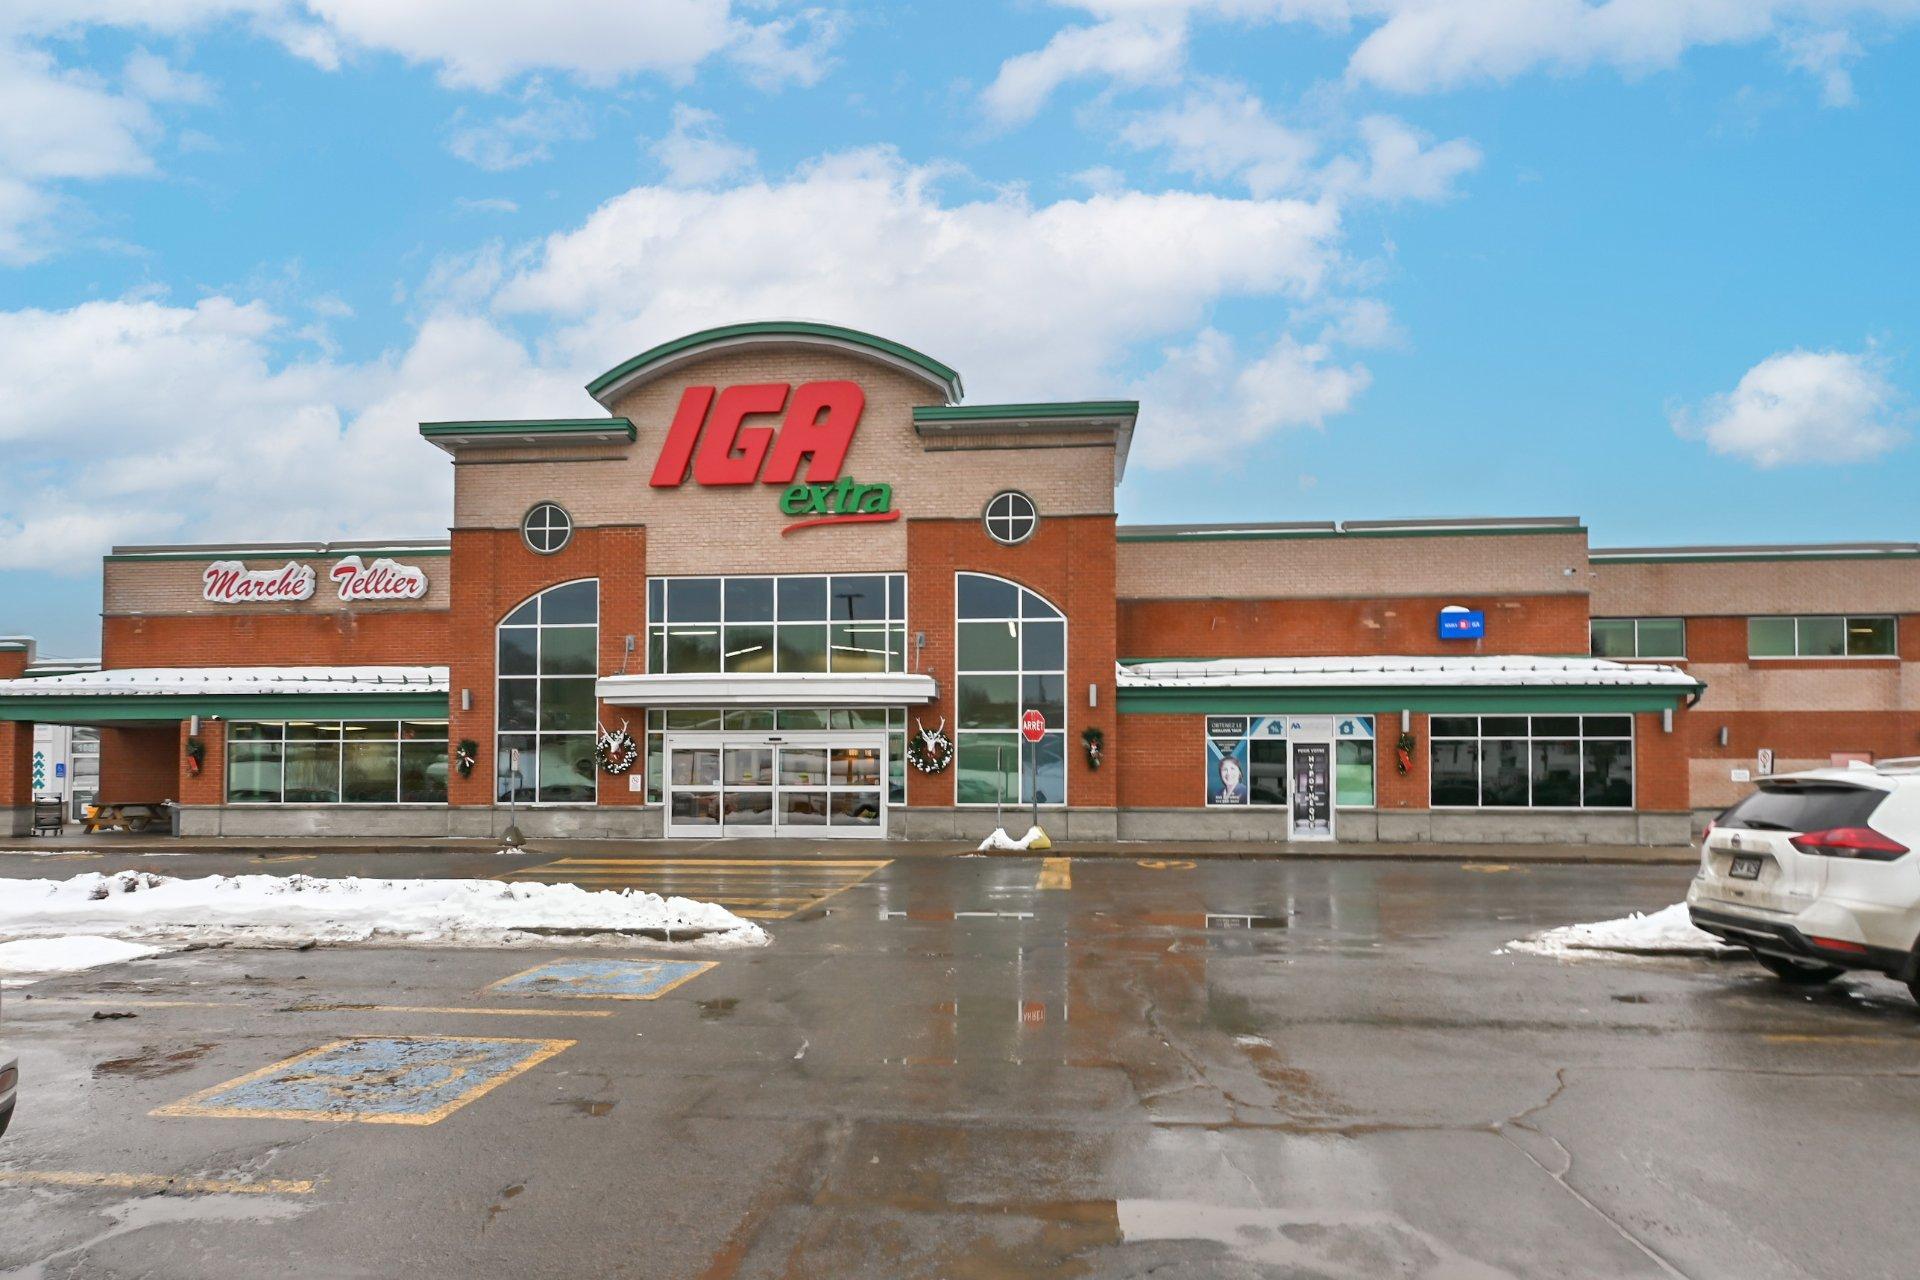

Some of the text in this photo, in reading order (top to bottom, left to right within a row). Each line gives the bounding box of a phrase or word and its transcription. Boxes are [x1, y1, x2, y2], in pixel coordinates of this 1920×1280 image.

[649, 380, 865, 487] IGA
[779, 476, 892, 516] extra
[206, 566, 420, 599] Marché Tellier
[1023, 719, 1044, 731] ARRÊT
